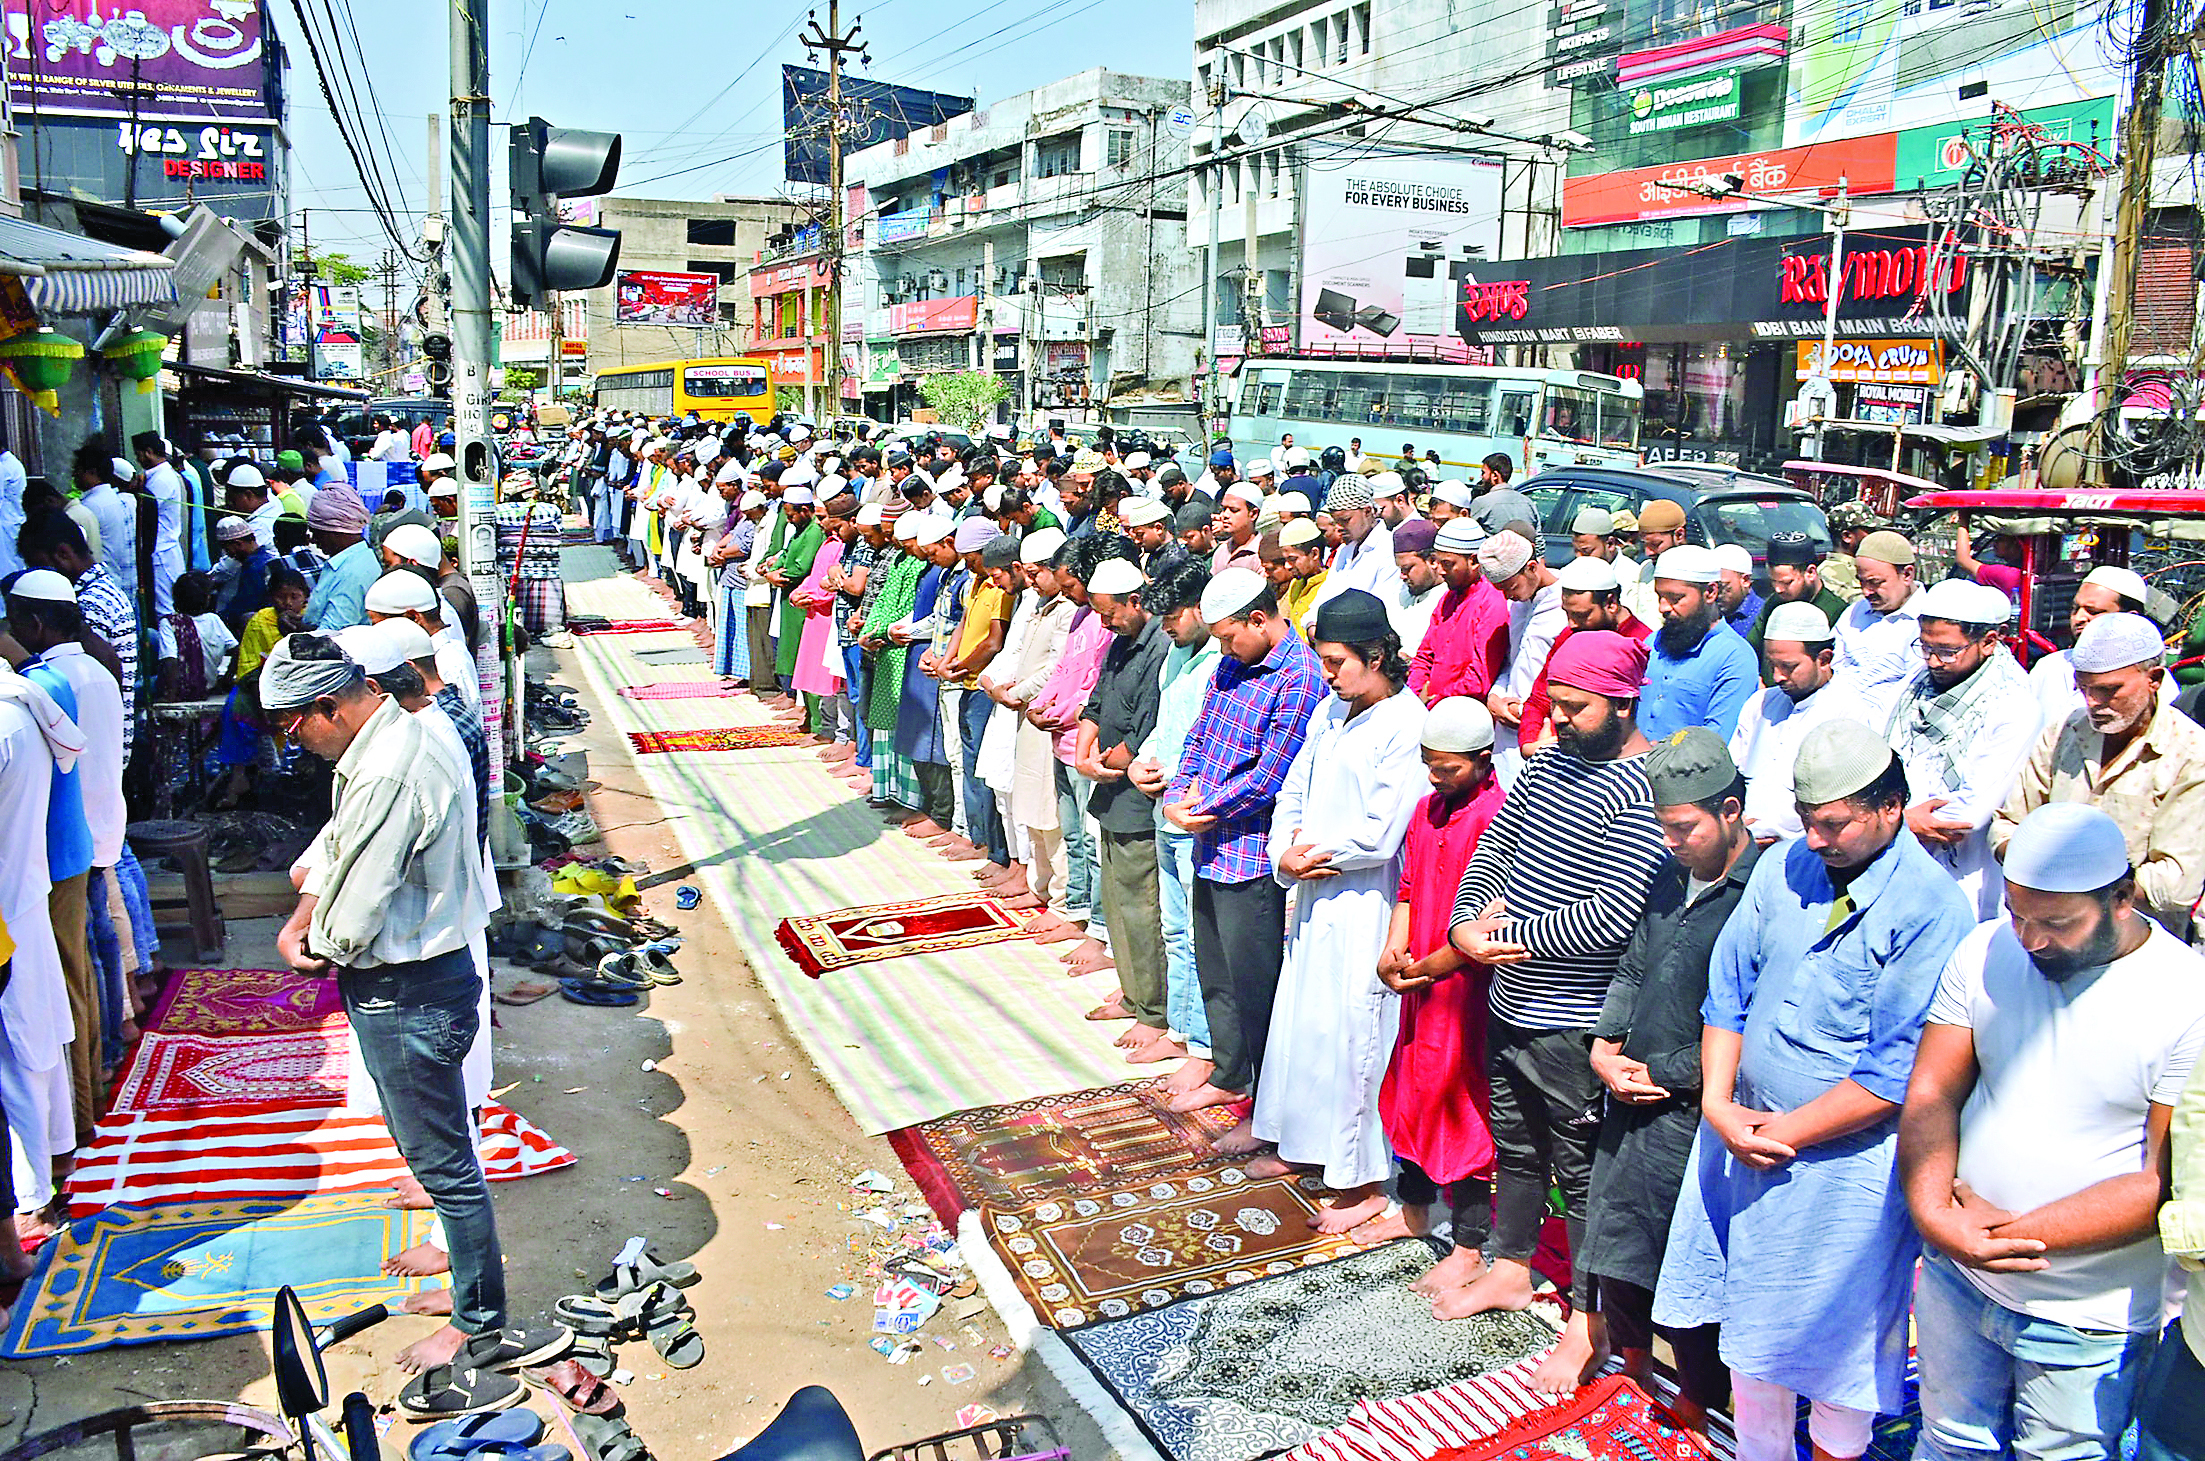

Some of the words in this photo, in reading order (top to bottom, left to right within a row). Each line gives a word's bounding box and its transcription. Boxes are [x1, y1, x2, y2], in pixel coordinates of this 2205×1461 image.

[1556, 58, 1608, 81] LIFESTYLE
[43, 74, 74, 85] RANGE
[75, 77, 88, 86] OF
[88, 79, 116, 89] SILVER
[156, 83, 207, 95] ORNAMENTS
[207, 86, 215, 95] &
[216, 87, 258, 98] JEWELLERY
[1629, 118, 1656, 135] SOUTH
[1656, 112, 1684, 131] INDIAN
[1684, 102, 1738, 126] RESTAURANT
[1846, 104, 1887, 117] DHALAI
[1846, 112, 1887, 126] EXPERT
[164, 159, 265, 179] DESIGNER
[1471, 158, 1504, 168] Canon
[1749, 158, 1787, 188] बैंक
[1346, 178, 1367, 191] THE
[1368, 181, 1424, 197] ABSOLUTE
[1425, 185, 1463, 201] CHOICE
[1345, 191, 1369, 206] FOR
[1371, 193, 1410, 209] EVERY
[1412, 197, 1469, 214] BUSINESS
[1478, 329, 1538, 343] HINDUSTAN
[1538, 328, 1571, 342] MART
[1585, 327, 1624, 340] FABER
[1754, 321, 1789, 337] IDBI
[1839, 318, 1887, 334] MAIN
[1878, 345, 1929, 370] CRUSH
[1859, 384, 1888, 400] ROYAL
[1887, 387, 1923, 402] MOBILE
